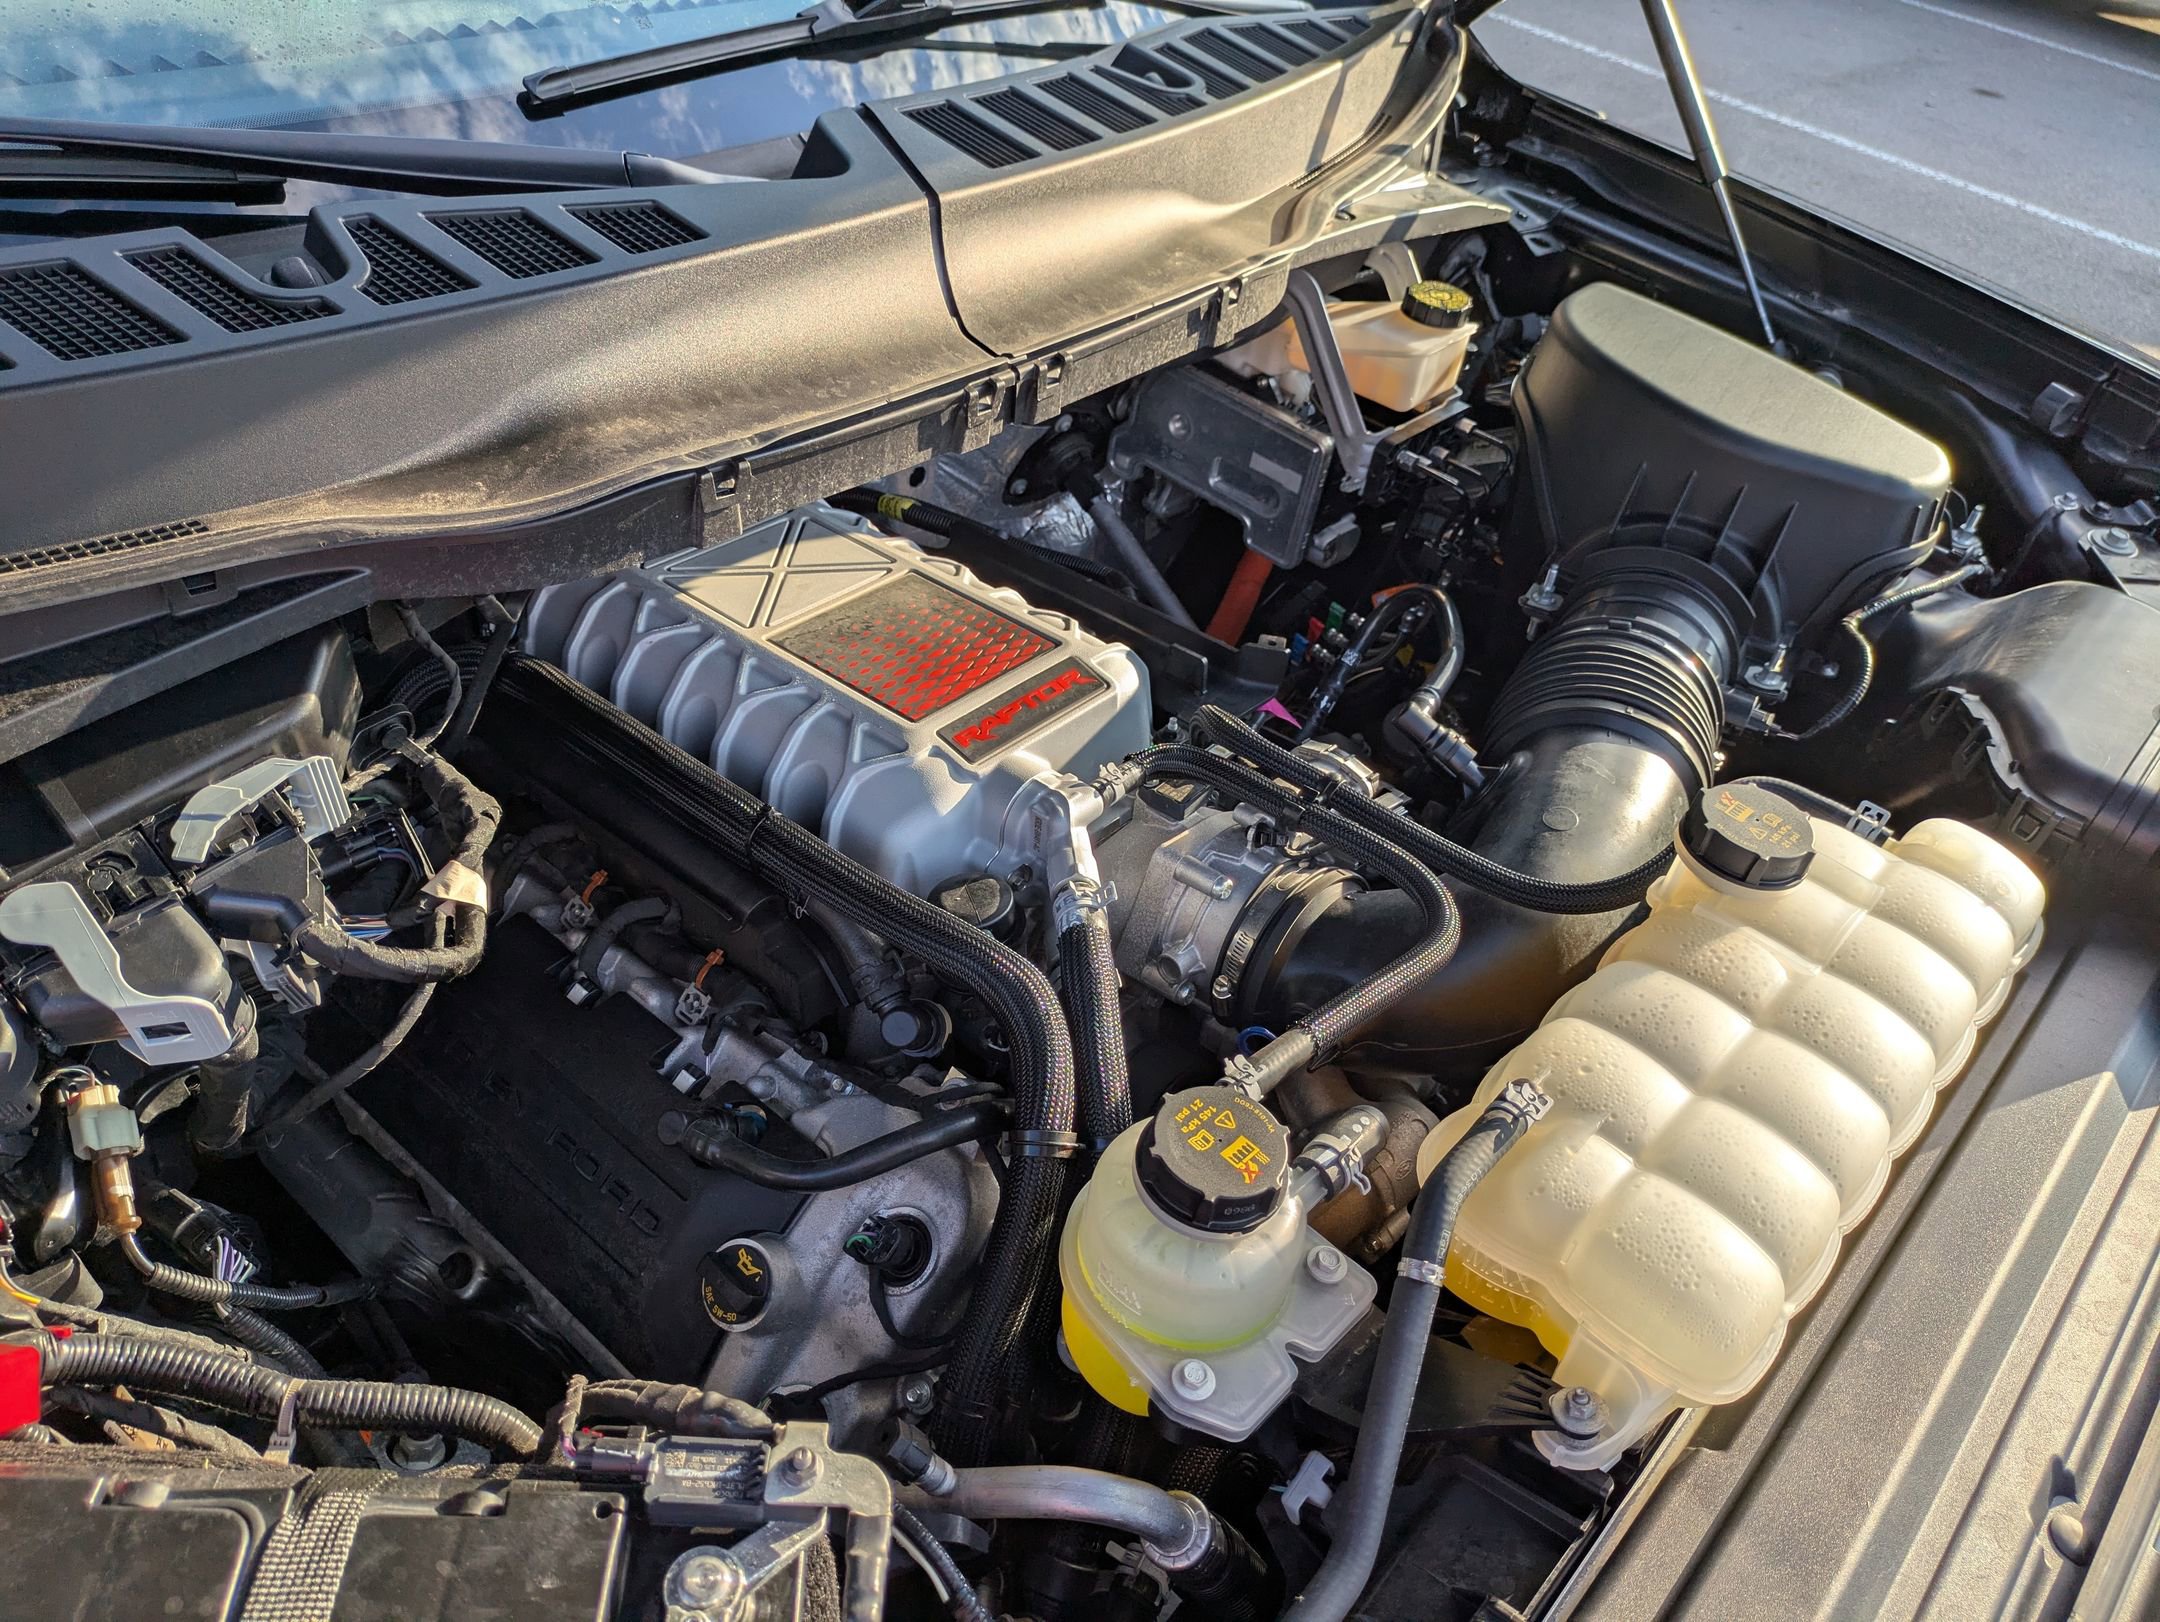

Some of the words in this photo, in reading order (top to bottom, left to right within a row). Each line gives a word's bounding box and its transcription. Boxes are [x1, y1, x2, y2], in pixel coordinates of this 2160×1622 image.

[952, 667, 1098, 749] RAPTOR
[1190, 1098, 1204, 1112] 21
[1199, 1105, 1217, 1121] 145
[1175, 1106, 1191, 1122] psi
[1181, 1117, 1202, 1134] kPa
[545, 1125, 661, 1238] FORD
[705, 1285, 715, 1305] SAE
[712, 1304, 737, 1322] 5W-50
